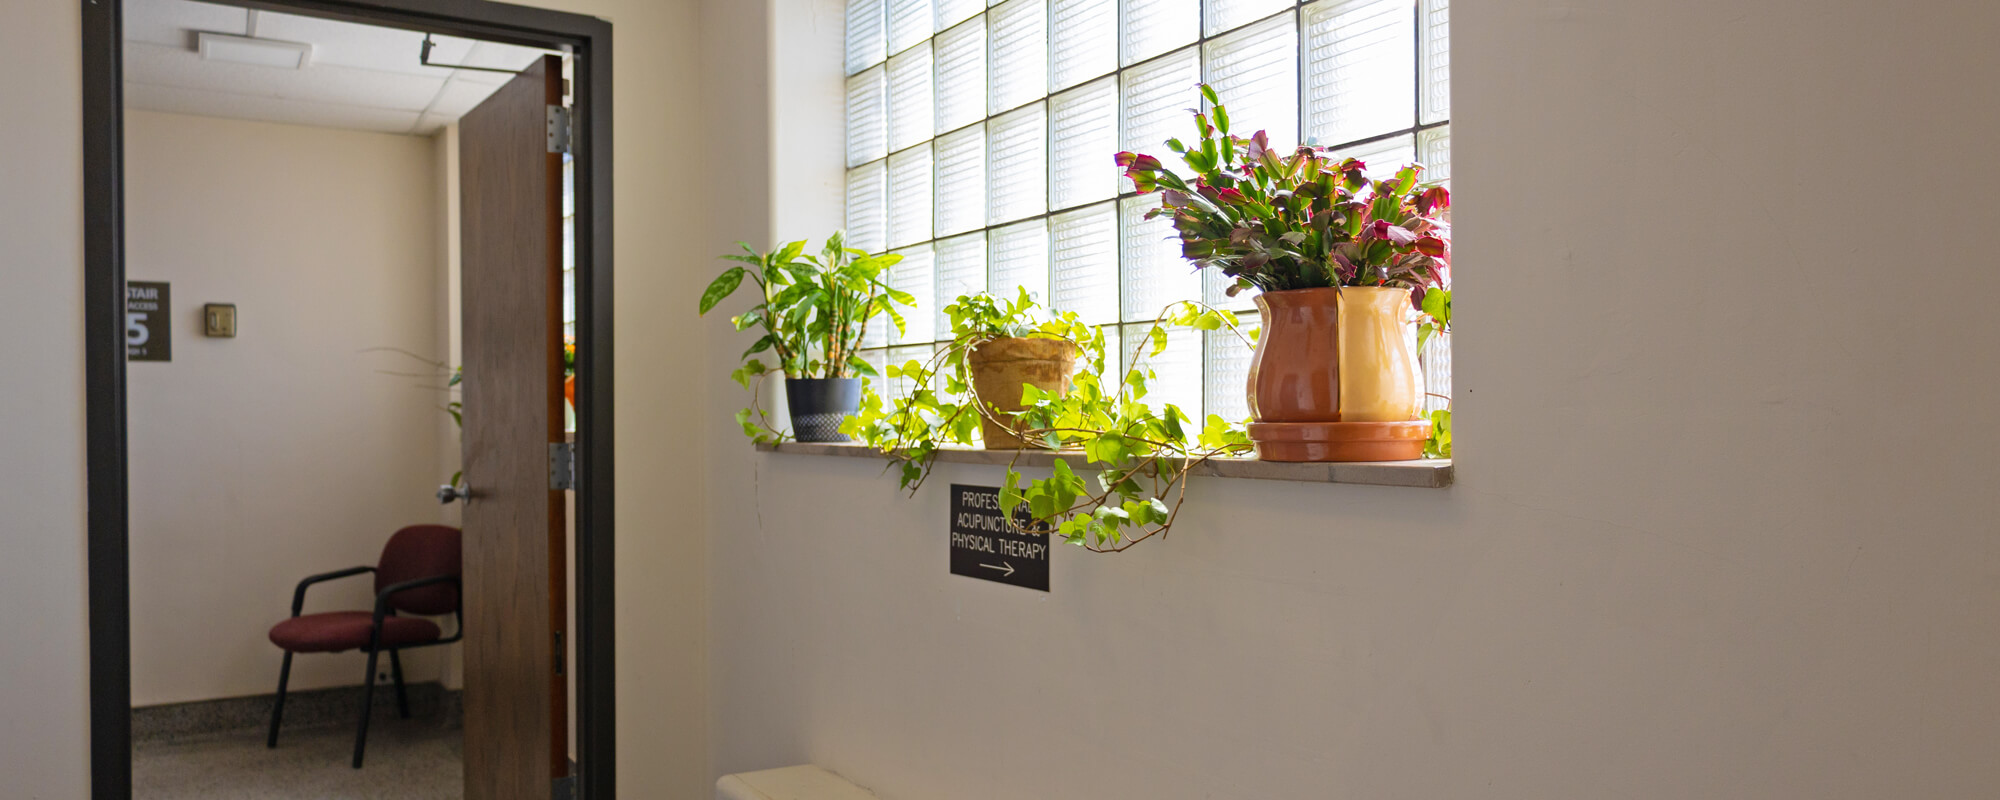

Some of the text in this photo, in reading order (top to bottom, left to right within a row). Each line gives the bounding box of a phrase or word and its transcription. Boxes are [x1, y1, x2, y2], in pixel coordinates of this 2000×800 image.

[127, 312, 149, 346] 5
[957, 512, 1026, 536] ACUPUNCTURE
[952, 532, 1046, 560] PHYSICAL THERAPY
